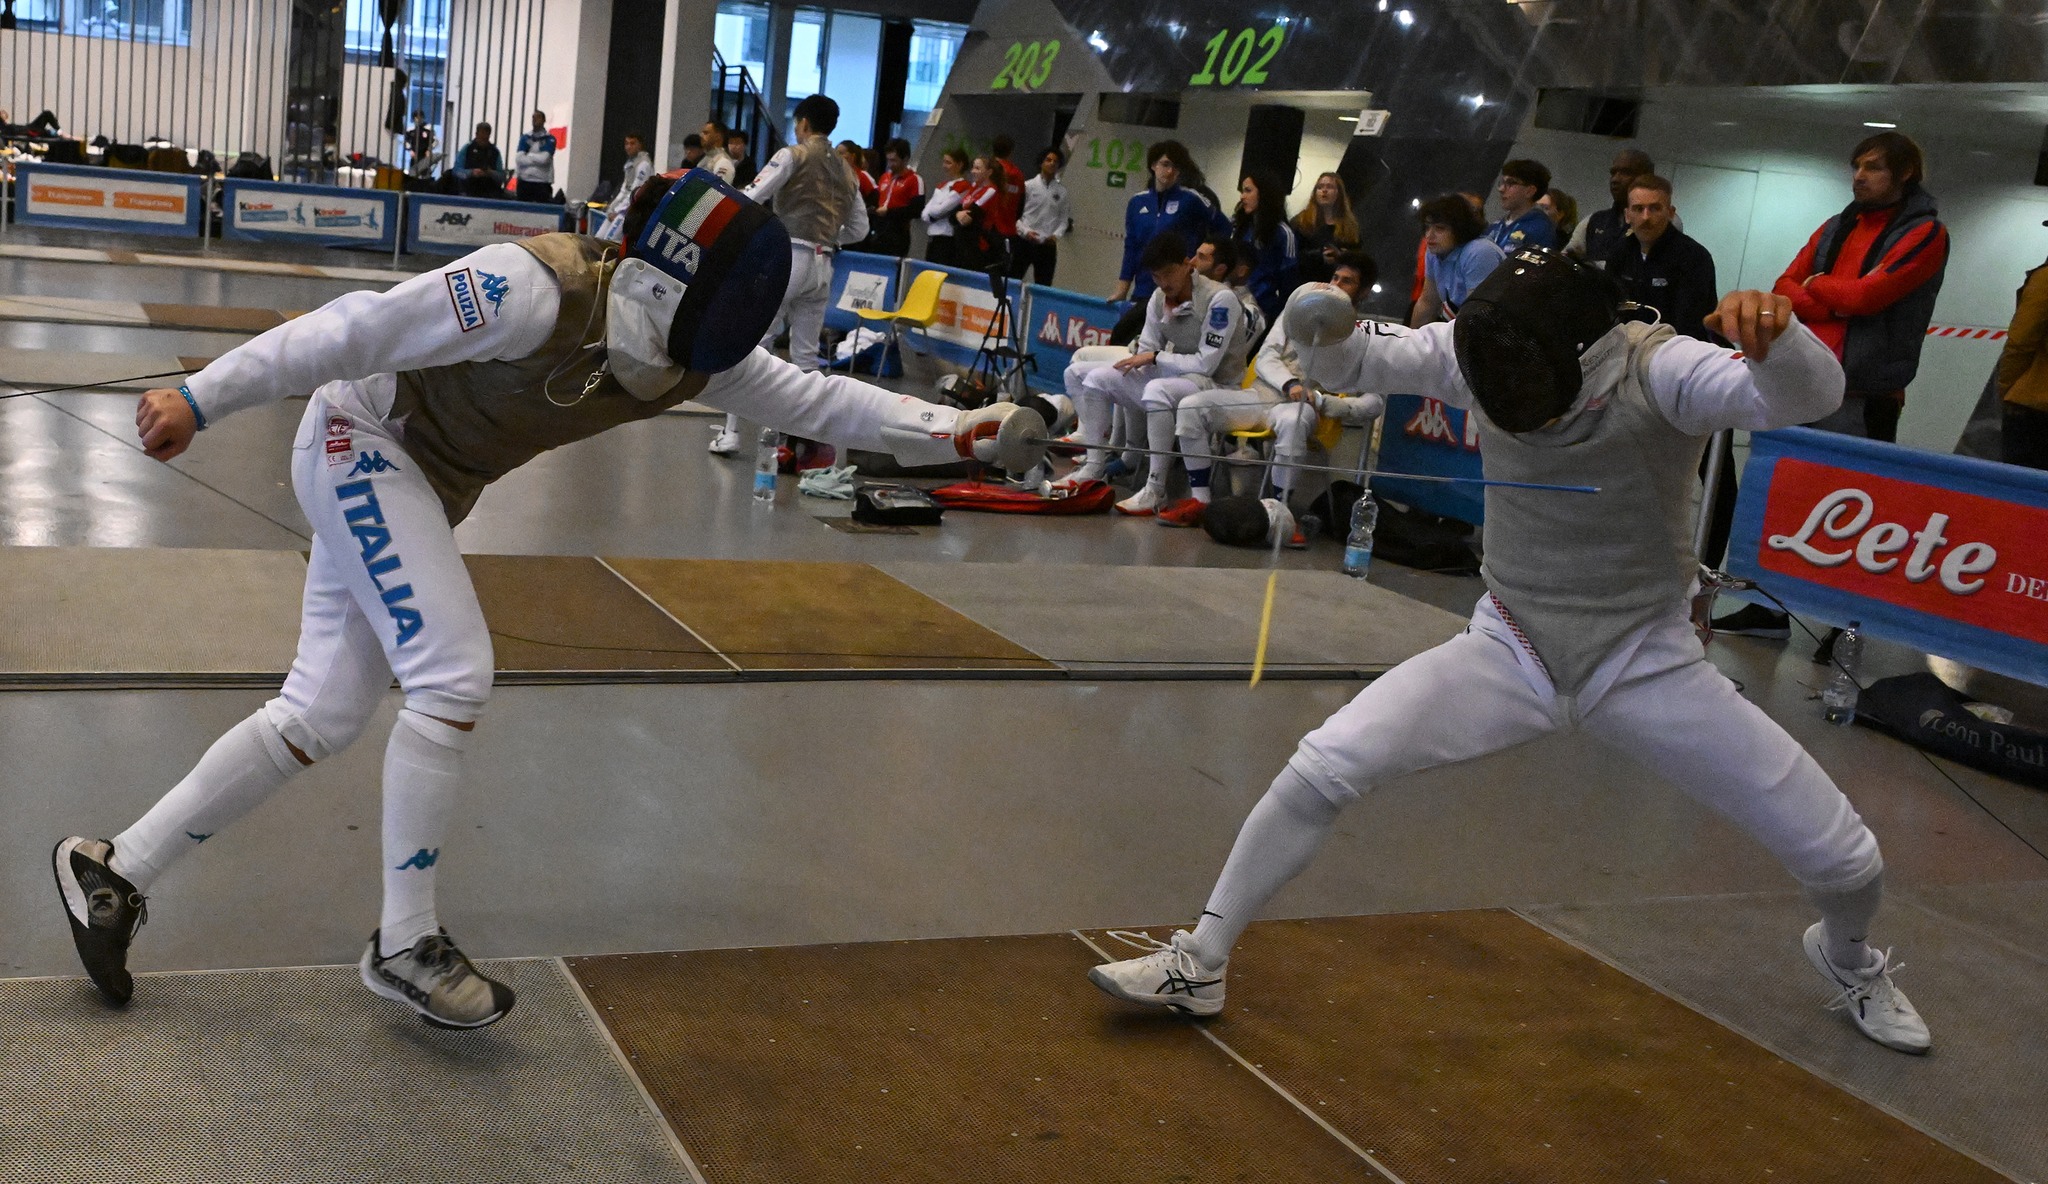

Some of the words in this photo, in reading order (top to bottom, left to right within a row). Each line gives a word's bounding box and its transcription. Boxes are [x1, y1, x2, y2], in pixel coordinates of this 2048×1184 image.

[991, 40, 1061, 89] 203
[1189, 25, 1285, 86] 102
[1086, 138, 1144, 171] 102
[647, 221, 701, 276] ITA
[452, 273, 478, 328] POLIZIA
[335, 478, 425, 647] ITALIA
[1768, 488, 1998, 595] Lete
[2006, 572, 2048, 602] DE
[1989, 729, 2047, 767] Paul
